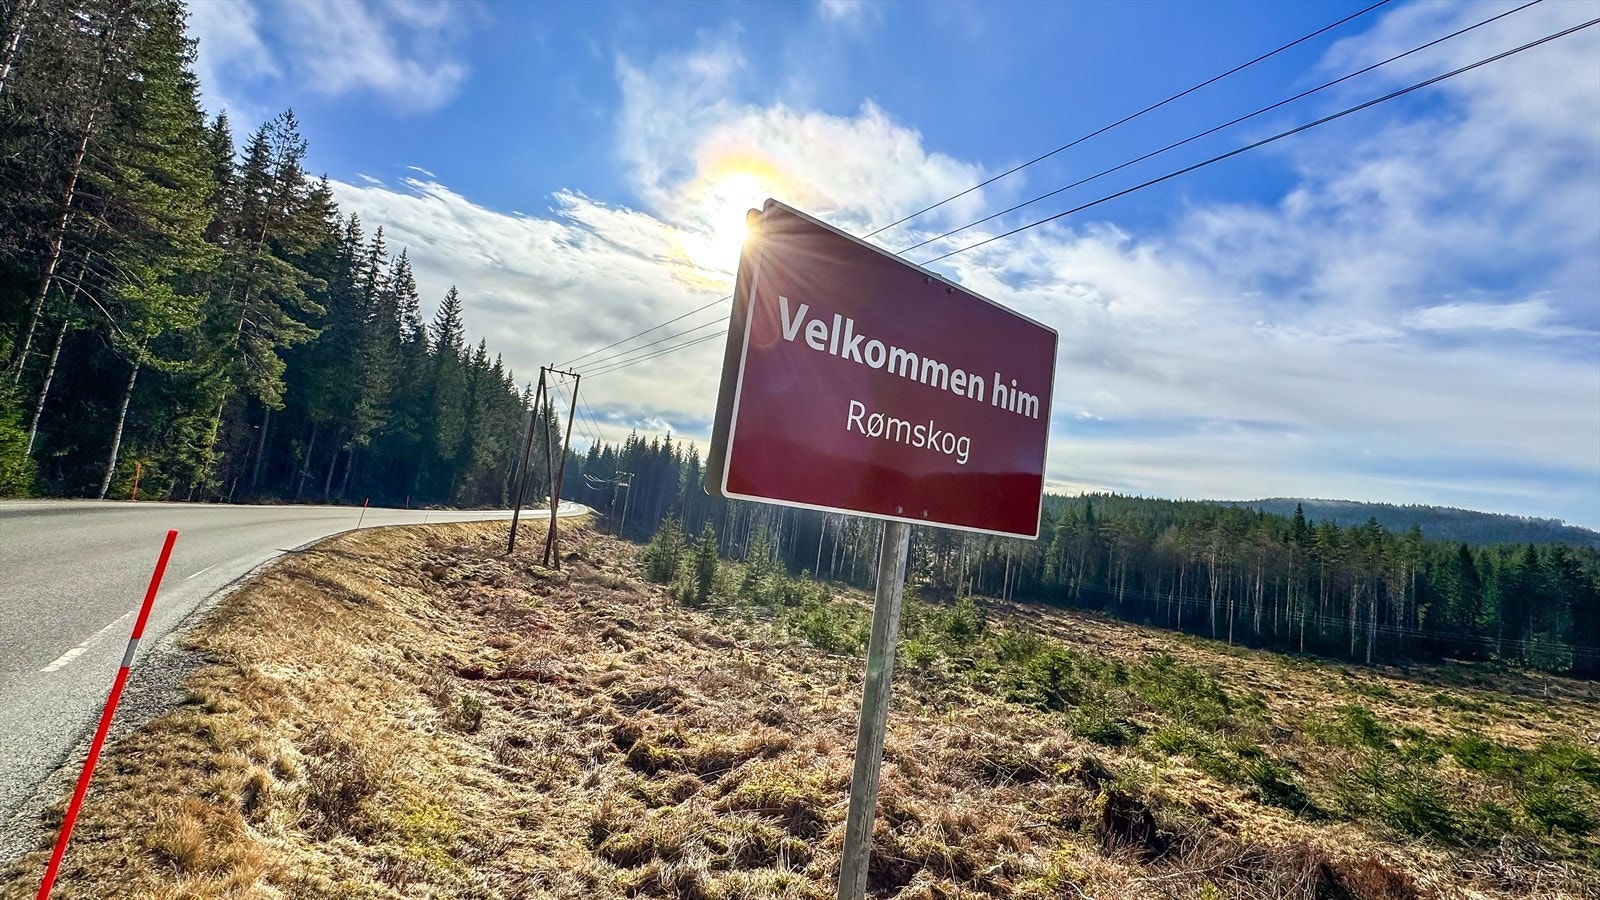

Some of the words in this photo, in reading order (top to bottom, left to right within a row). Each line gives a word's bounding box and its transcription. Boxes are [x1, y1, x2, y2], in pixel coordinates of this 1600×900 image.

[778, 295, 985, 402] Velkommen
[991, 372, 1040, 419] him
[846, 400, 971, 464] Rømskog
